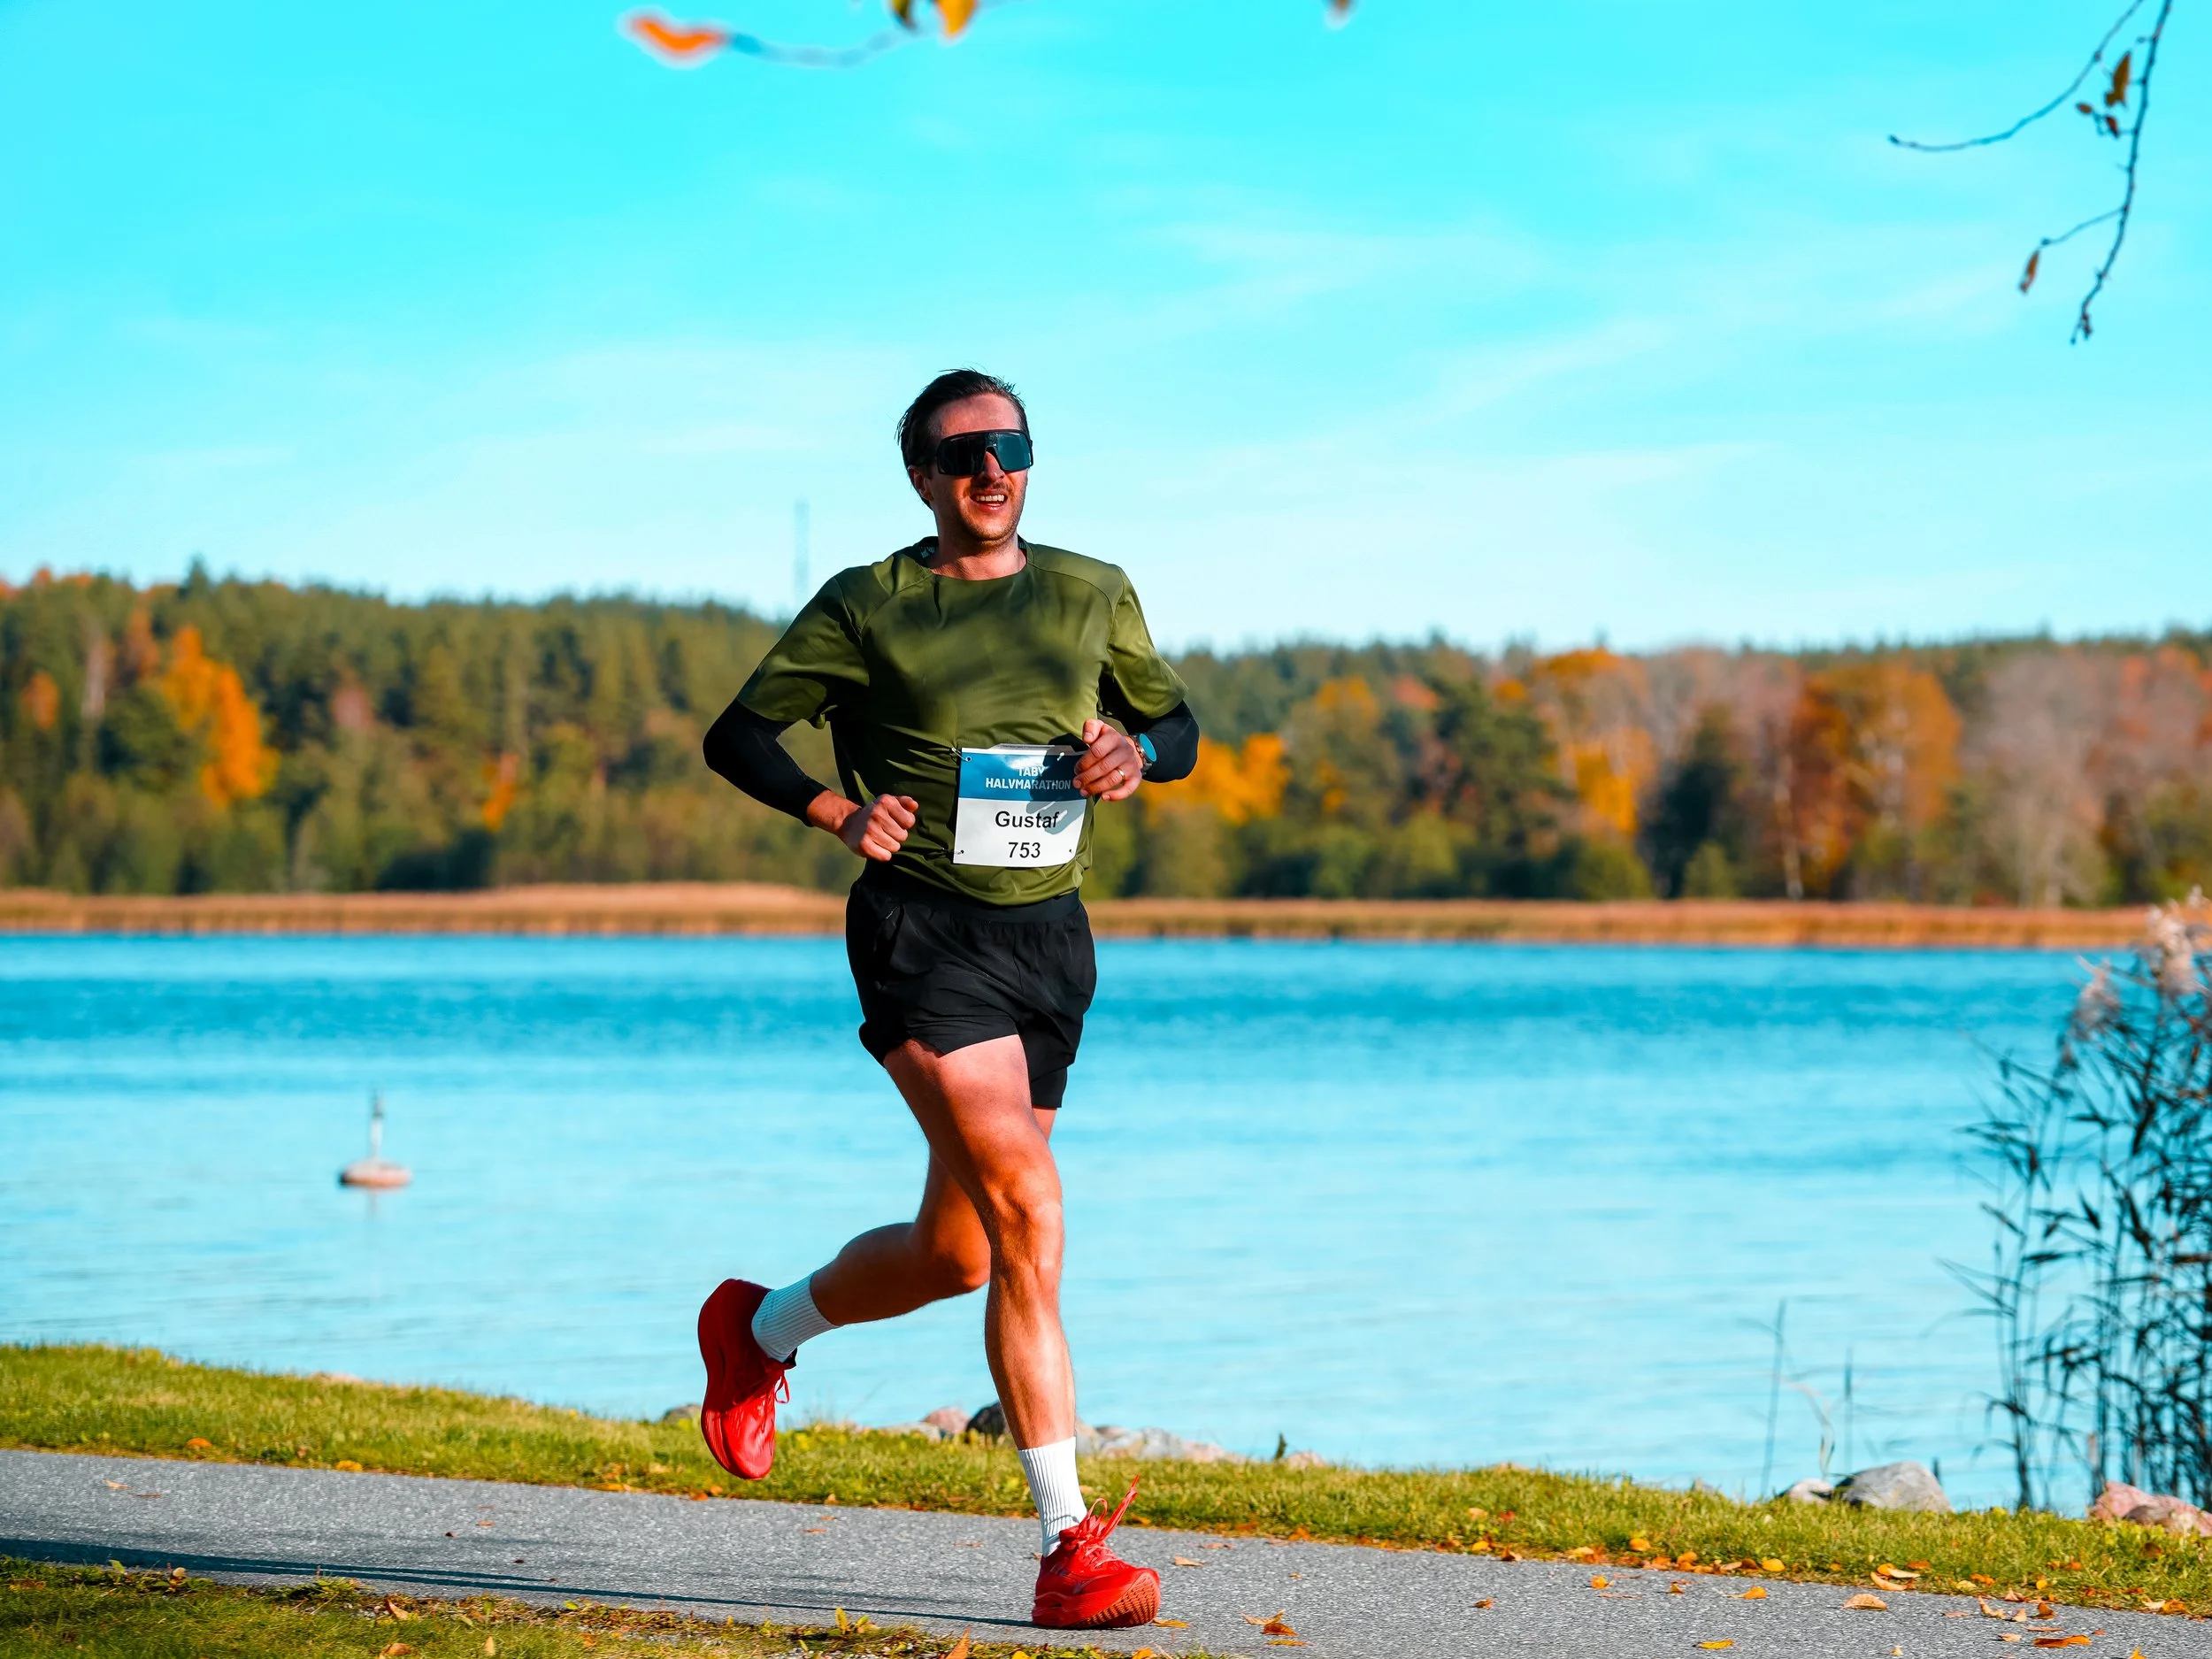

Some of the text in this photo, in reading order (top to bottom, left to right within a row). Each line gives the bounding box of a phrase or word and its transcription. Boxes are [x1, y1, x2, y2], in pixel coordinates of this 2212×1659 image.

[985, 777, 1071, 790] HALVMARATHON
[995, 810, 1060, 828] Gustaf
[1008, 841, 1041, 858] 753
